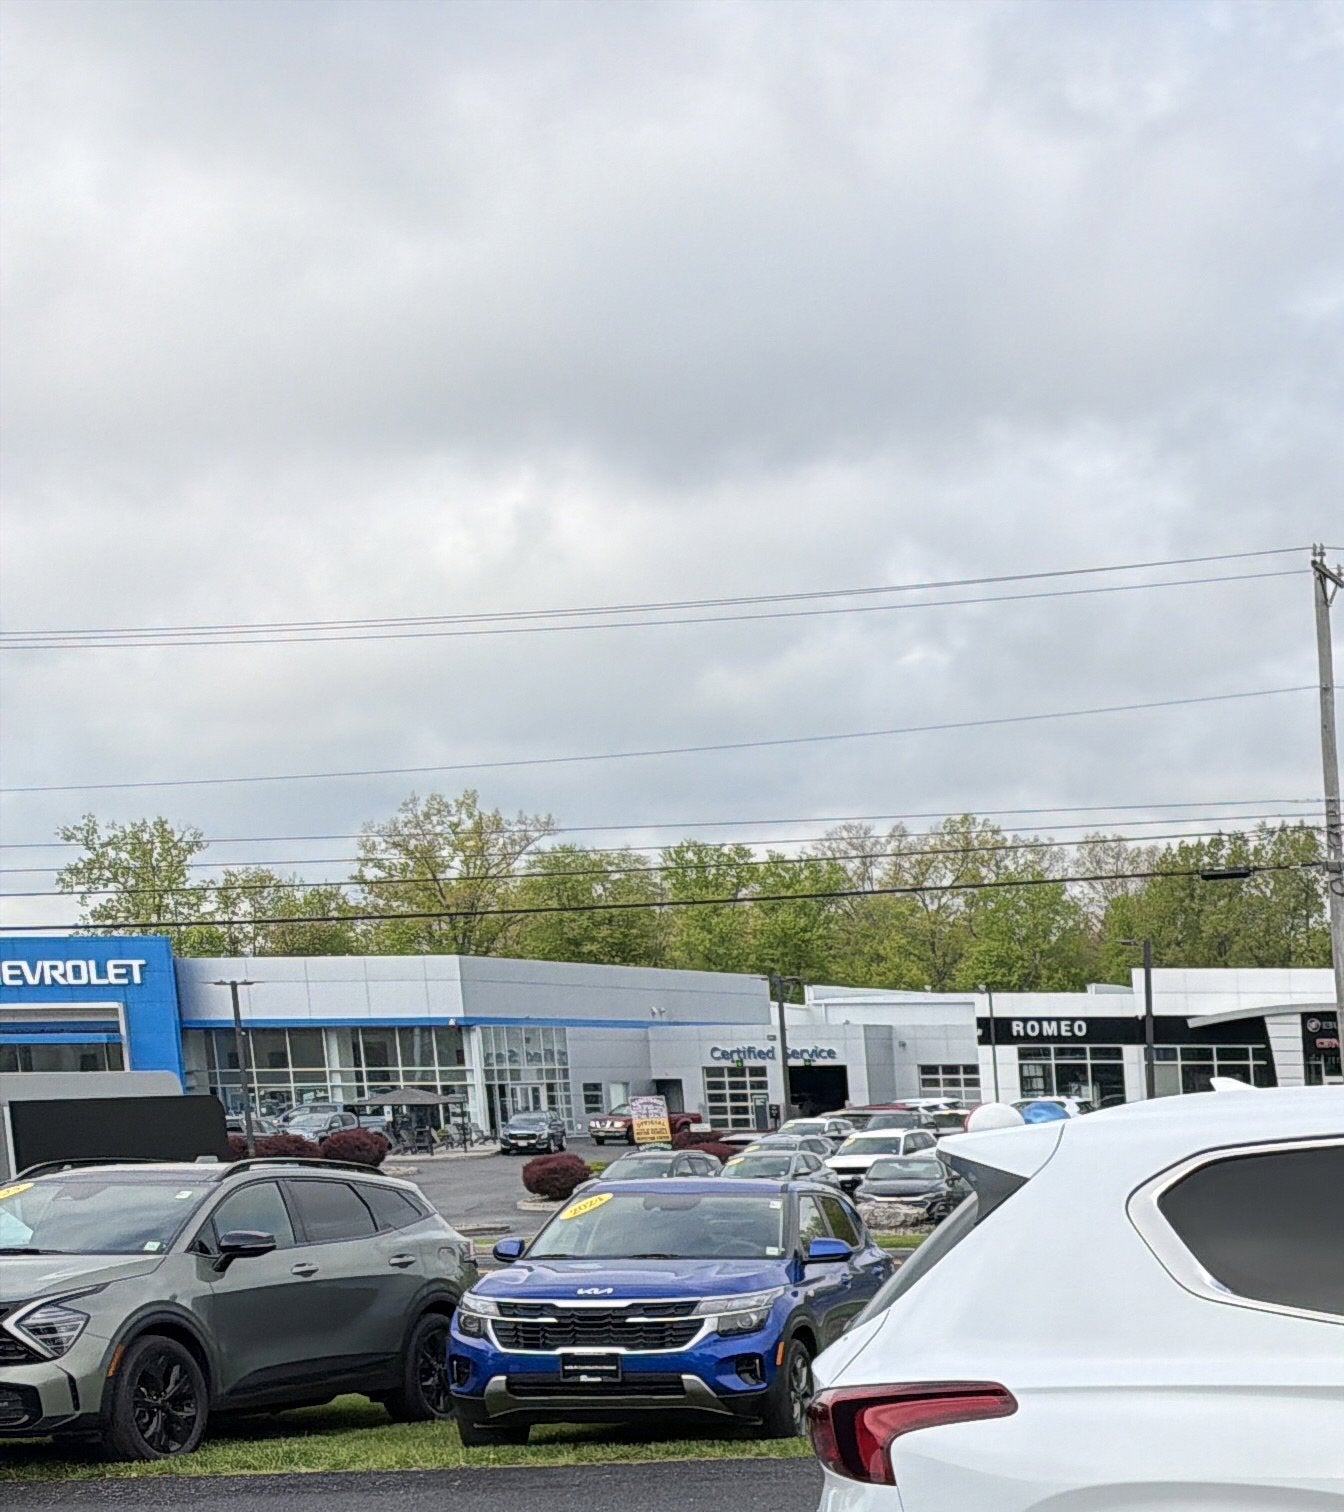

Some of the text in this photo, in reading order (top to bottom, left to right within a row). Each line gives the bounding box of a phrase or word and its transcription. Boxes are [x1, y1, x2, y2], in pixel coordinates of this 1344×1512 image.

[0, 960, 147, 985] EVROLET
[1011, 1020, 1088, 1037] ROMEO
[710, 1045, 777, 1061] Certified
